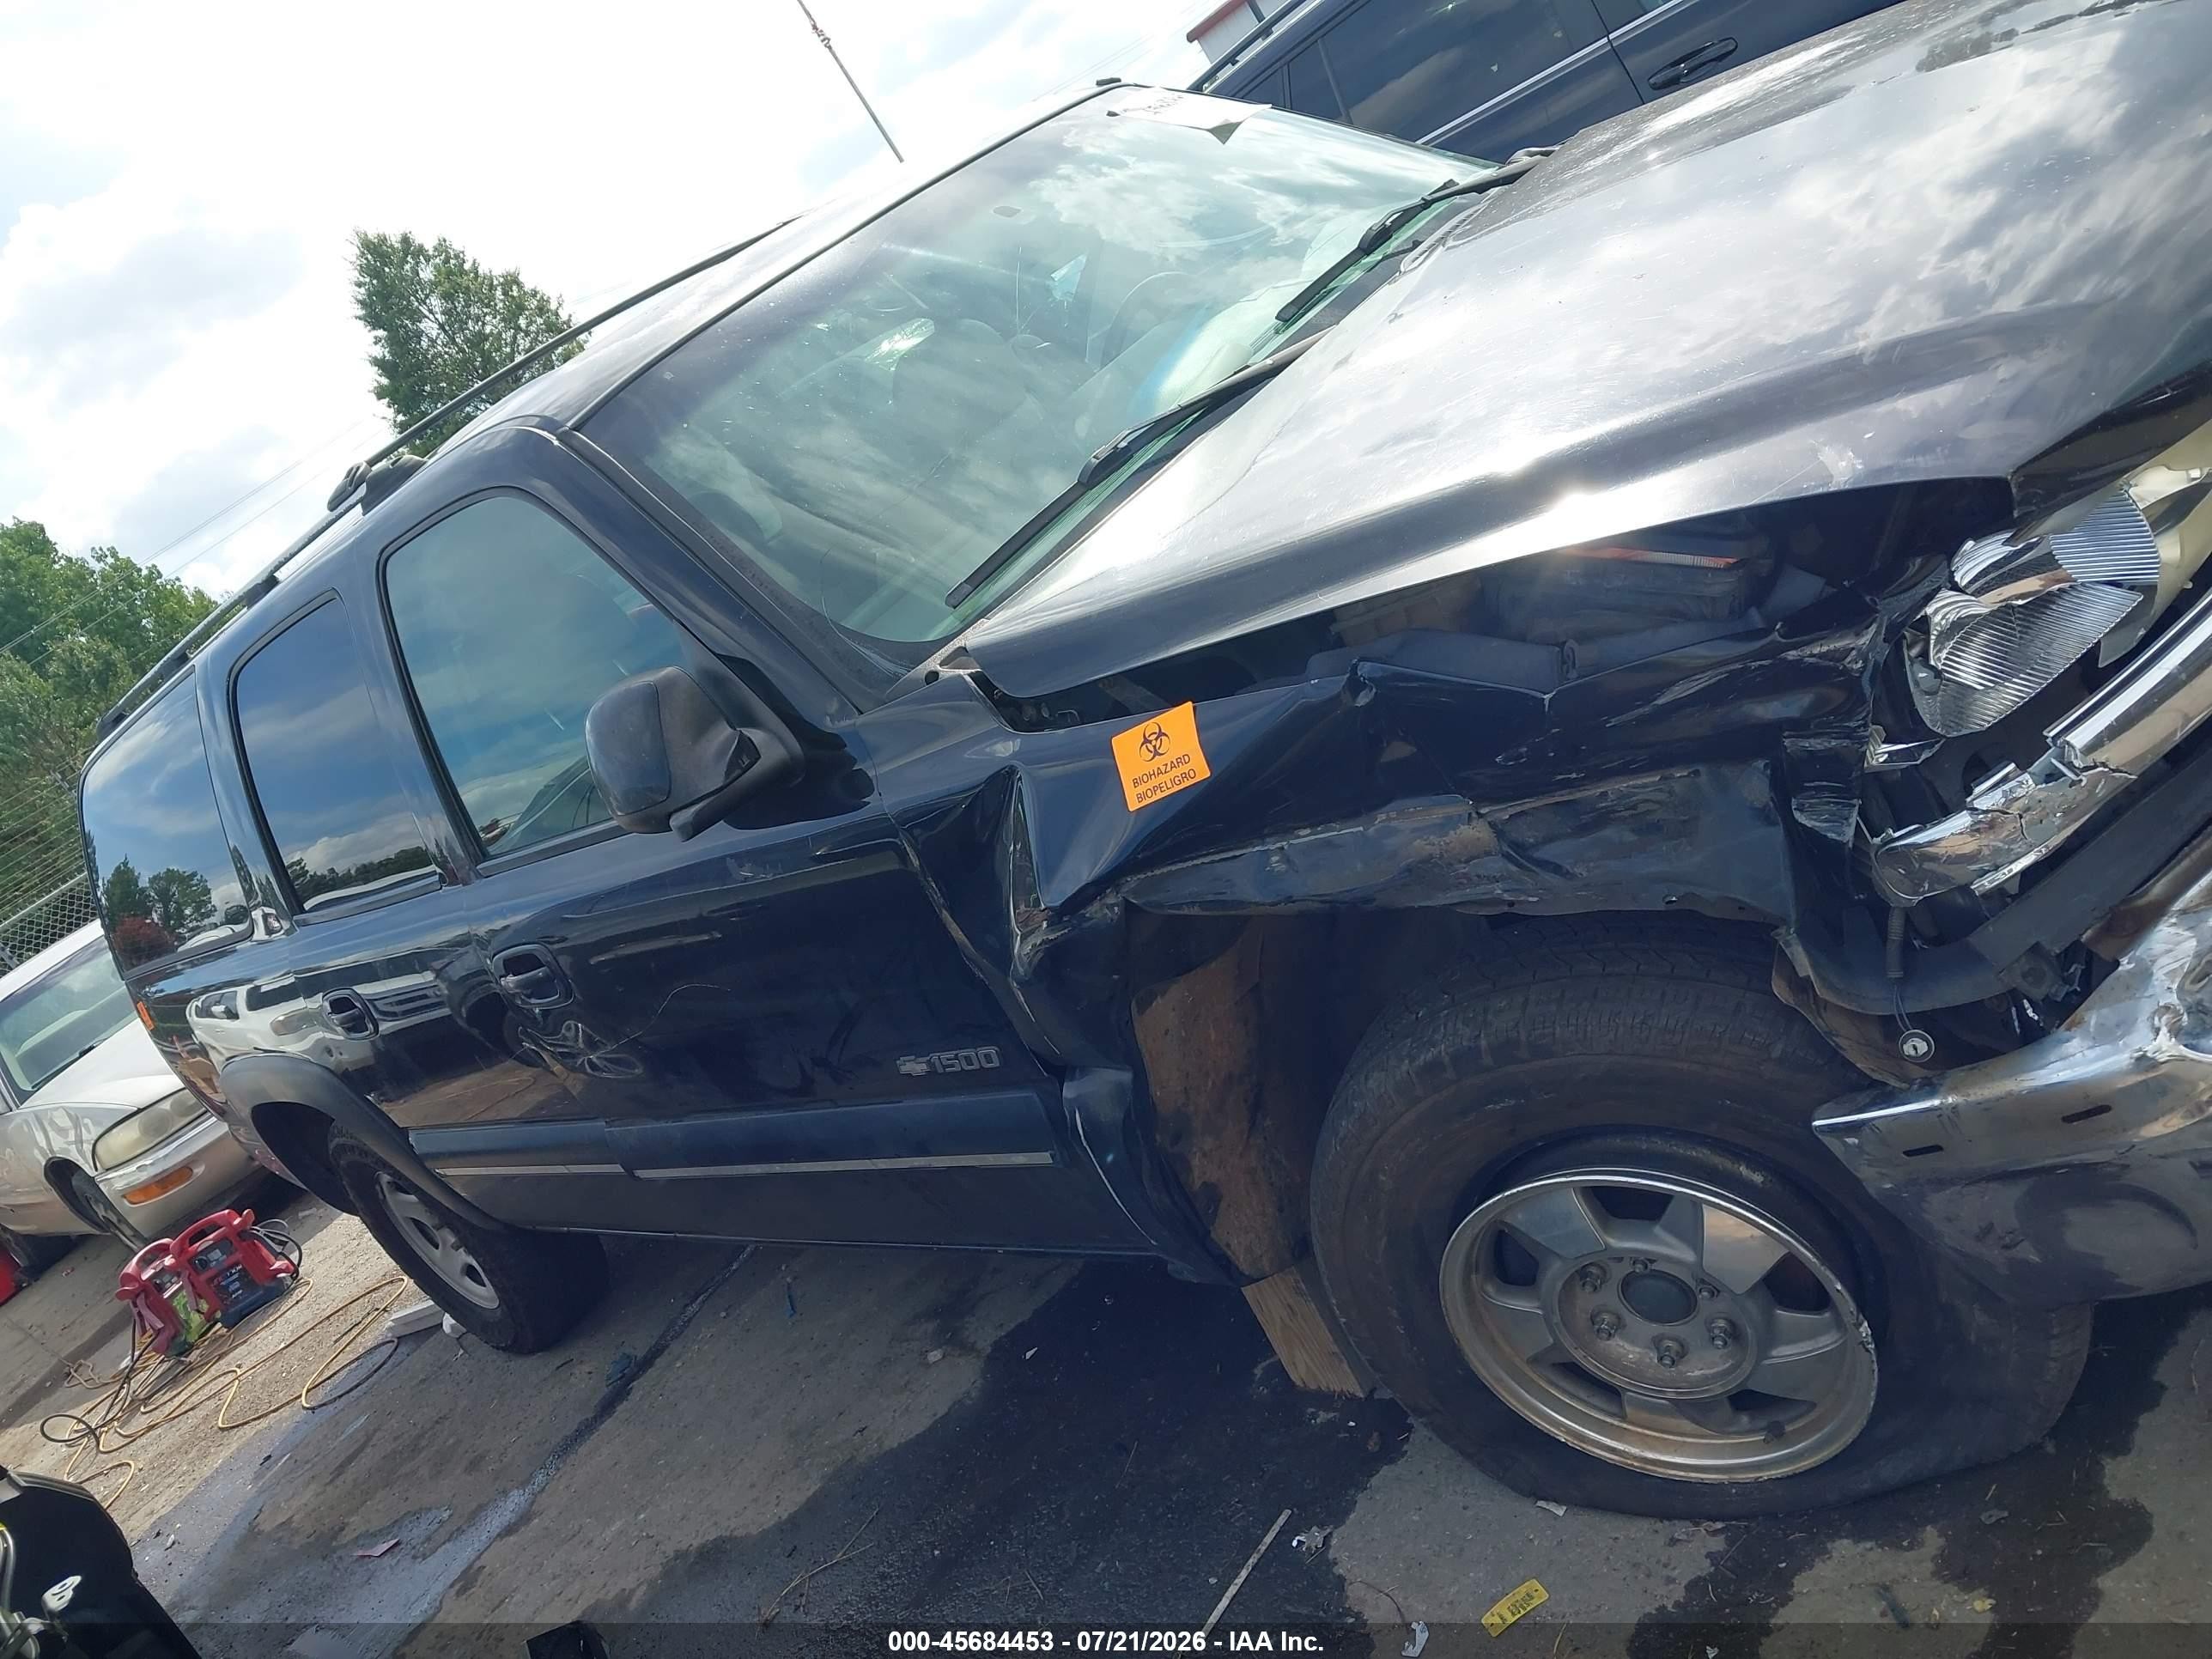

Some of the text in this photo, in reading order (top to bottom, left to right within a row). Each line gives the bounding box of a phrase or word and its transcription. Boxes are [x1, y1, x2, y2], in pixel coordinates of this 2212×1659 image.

[1132, 753, 1191, 788] BIOHAZARD
[1135, 768, 1197, 804] BIOPELIGRO
[929, 1046, 1001, 1073] 1500
